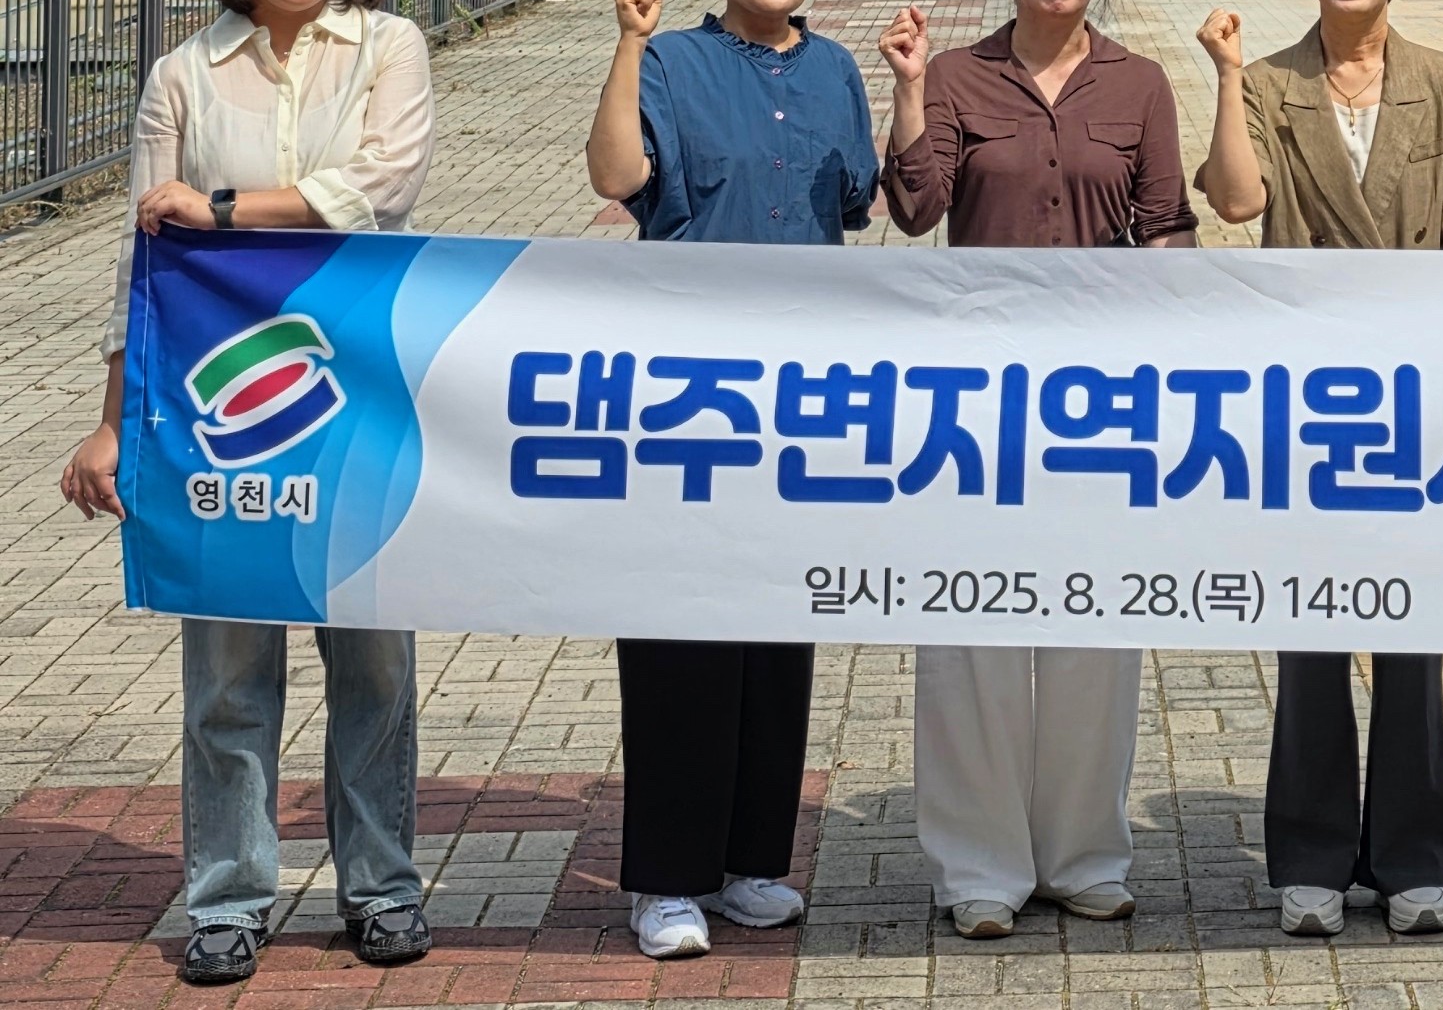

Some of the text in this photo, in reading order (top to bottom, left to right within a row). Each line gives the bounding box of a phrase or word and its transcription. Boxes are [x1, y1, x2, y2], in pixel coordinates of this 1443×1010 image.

[194, 480, 309, 515] 영천시
[805, 567, 1411, 623] 일시: 2025. 8. 28.(목) 14:00
